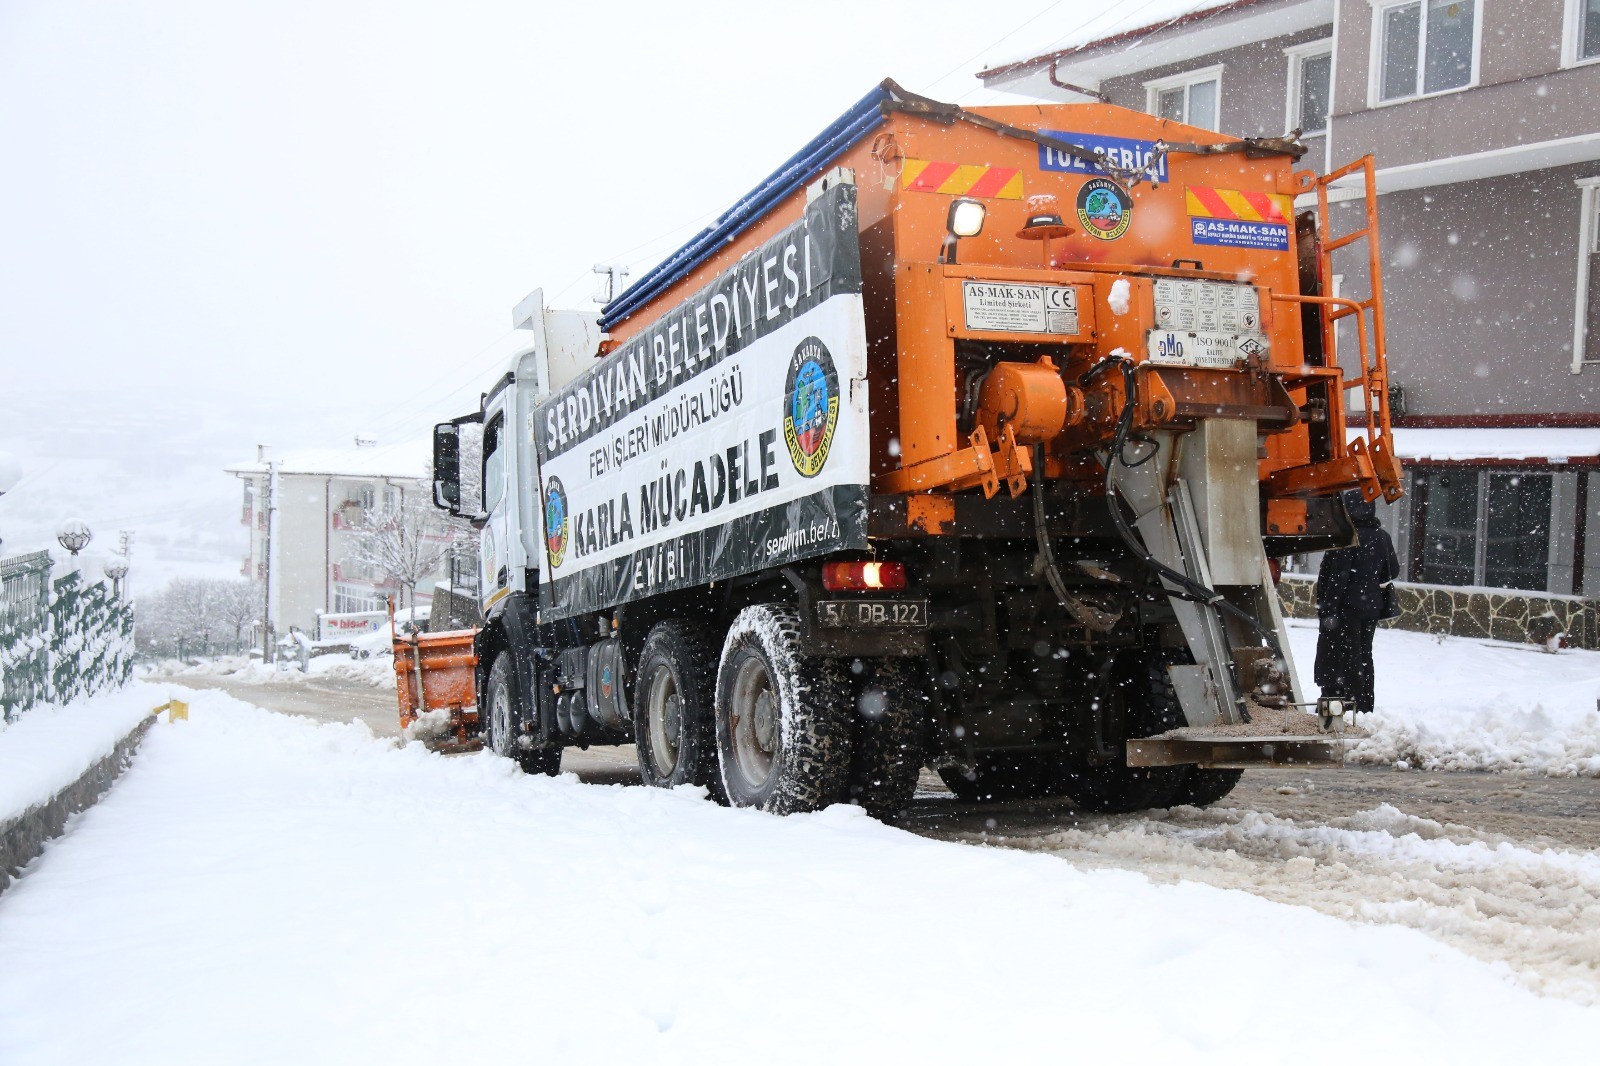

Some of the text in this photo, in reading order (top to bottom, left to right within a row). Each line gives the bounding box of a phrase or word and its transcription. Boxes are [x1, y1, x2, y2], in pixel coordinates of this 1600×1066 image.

[1207, 222, 1287, 237] AS-MAK-SAN
[969, 286, 1040, 300] AS-MAK-SAN
[979, 299, 1032, 309] Limited Şirketi
[547, 219, 812, 452] SERDİVAN BELEDİYESİ
[1159, 333, 1184, 358] DMO
[1196, 337, 1213, 346] ISO
[794, 344, 821, 371] SAKARYA
[590, 364, 743, 479] FEN İŞLERİ MÜDÜRLÜĞÜ
[574, 492, 634, 559] KARLA
[640, 428, 780, 535] MÜCADELE
[635, 540, 685, 590] EKİBİ
[859, 603, 885, 623] DB
[892, 604, 919, 623] 122
